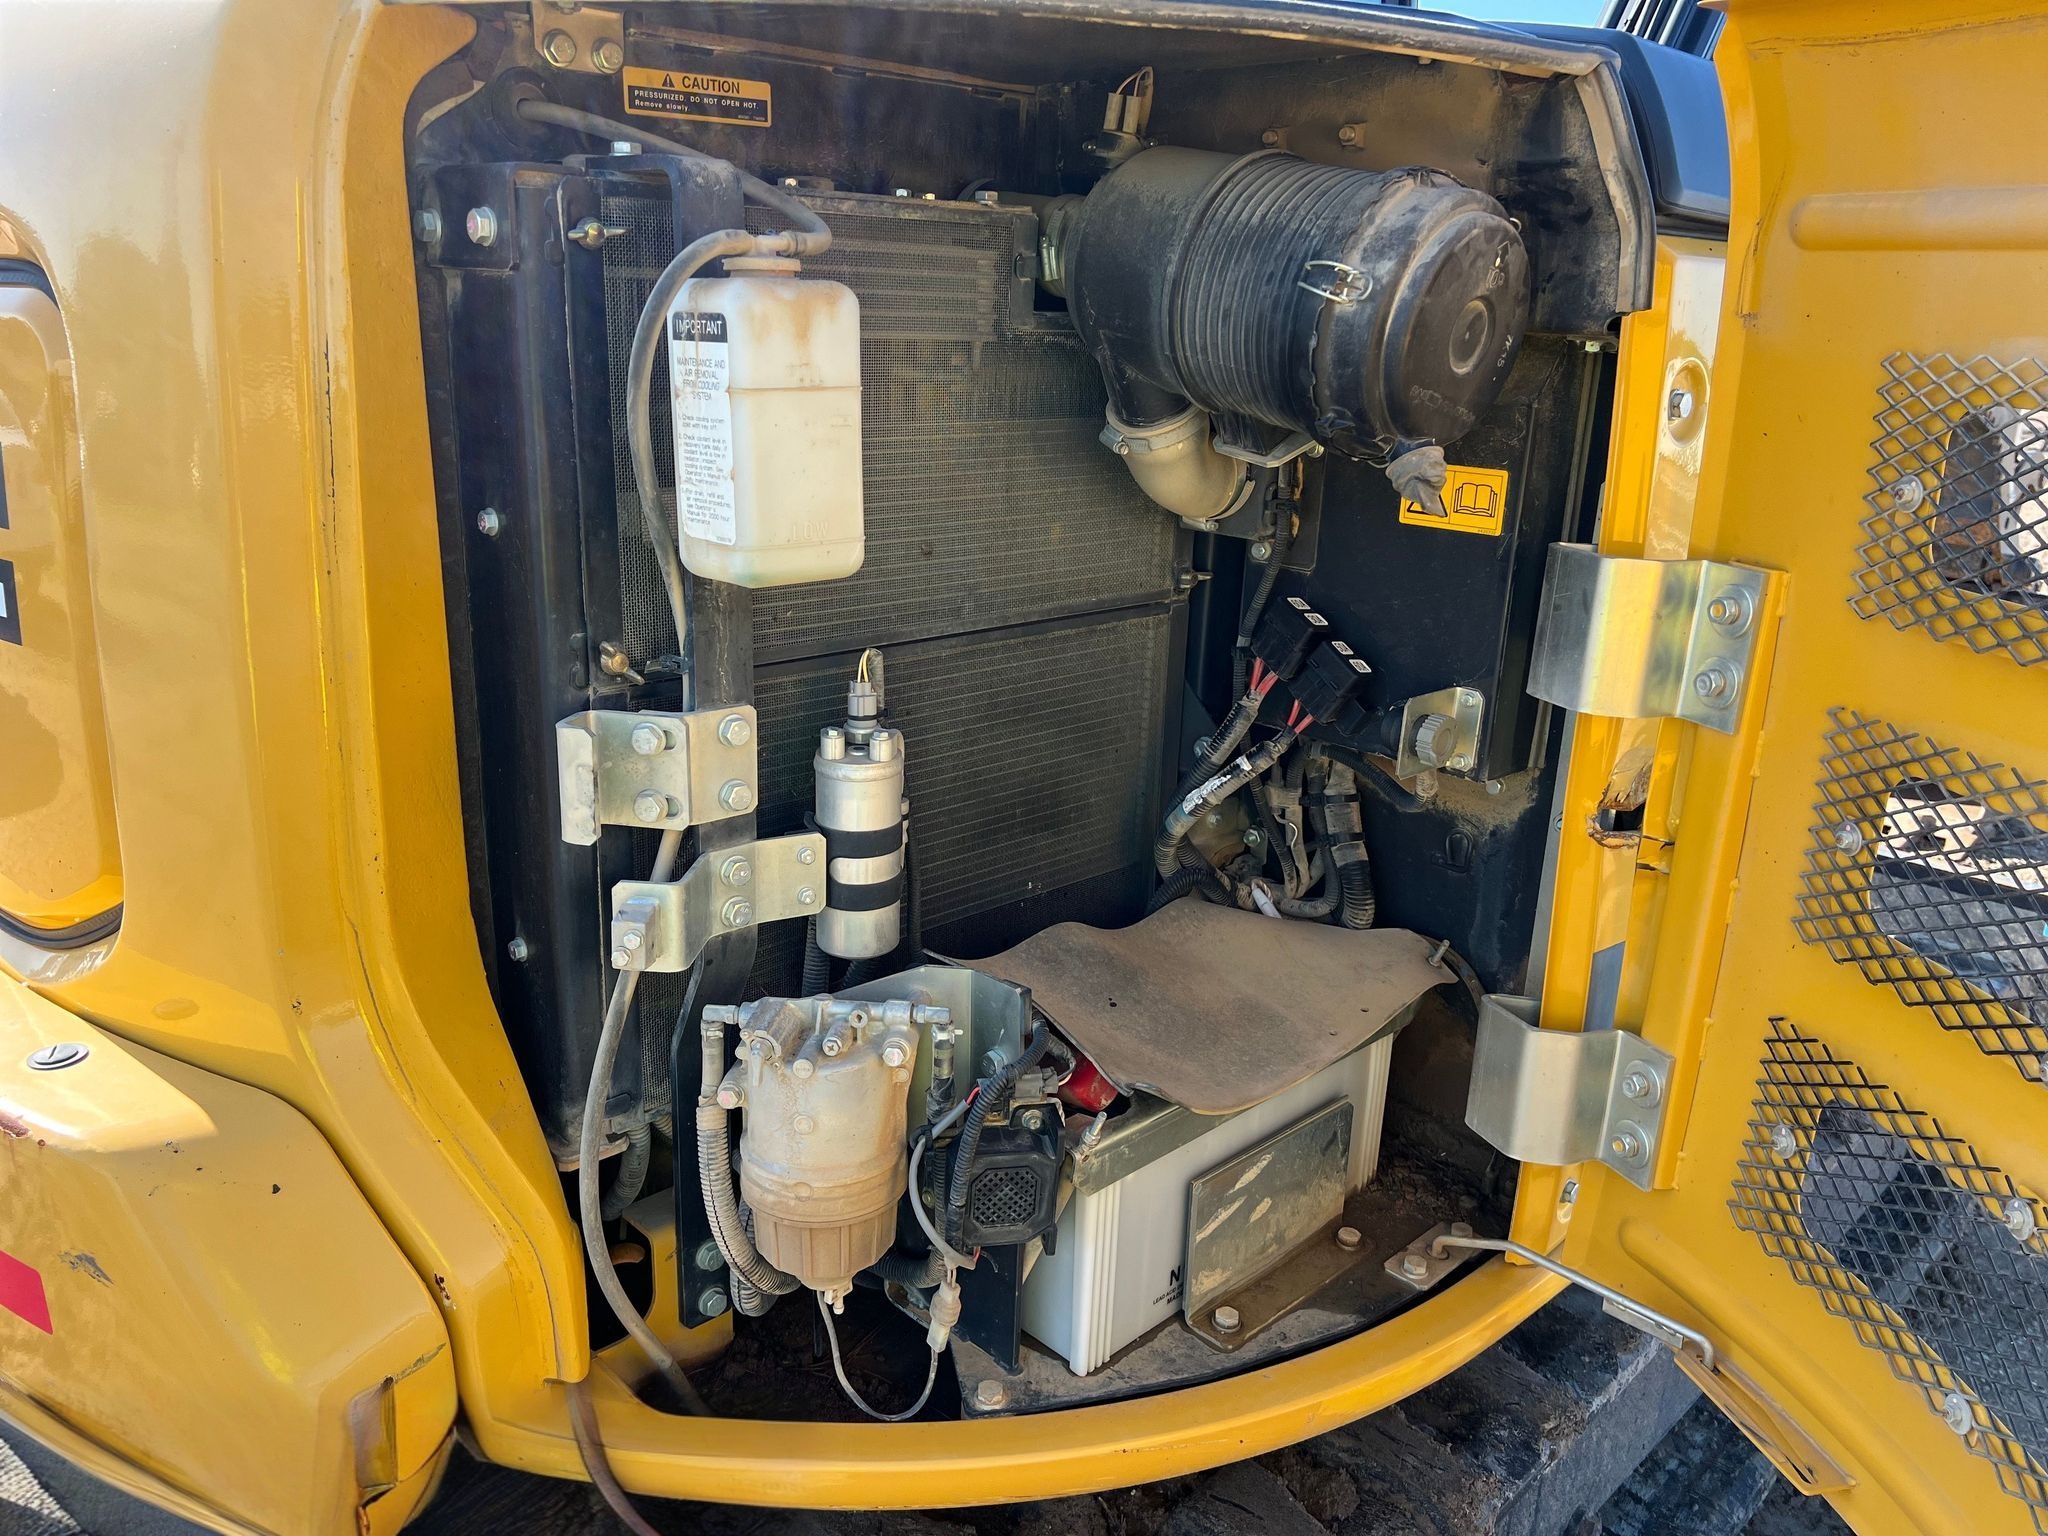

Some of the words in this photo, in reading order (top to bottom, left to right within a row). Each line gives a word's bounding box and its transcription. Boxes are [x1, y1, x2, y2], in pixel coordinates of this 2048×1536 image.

[682, 75, 740, 95] CAUTION
[634, 99, 663, 109] Remove
[690, 95, 700, 103] DO
[703, 97, 718, 105] NOT
[721, 99, 740, 107] OPEN
[743, 102, 759, 110] HOT.
[676, 319, 722, 335] IMPORTANT
[714, 359, 726, 369] AND
[684, 368, 693, 377] AIR
[694, 368, 719, 380] REMOVAL
[698, 380, 720, 391] COOLING
[691, 390, 712, 401] SYSTEM
[1152, 1293, 1166, 1305] LEAD
[1165, 1286, 1177, 1298] ACID
